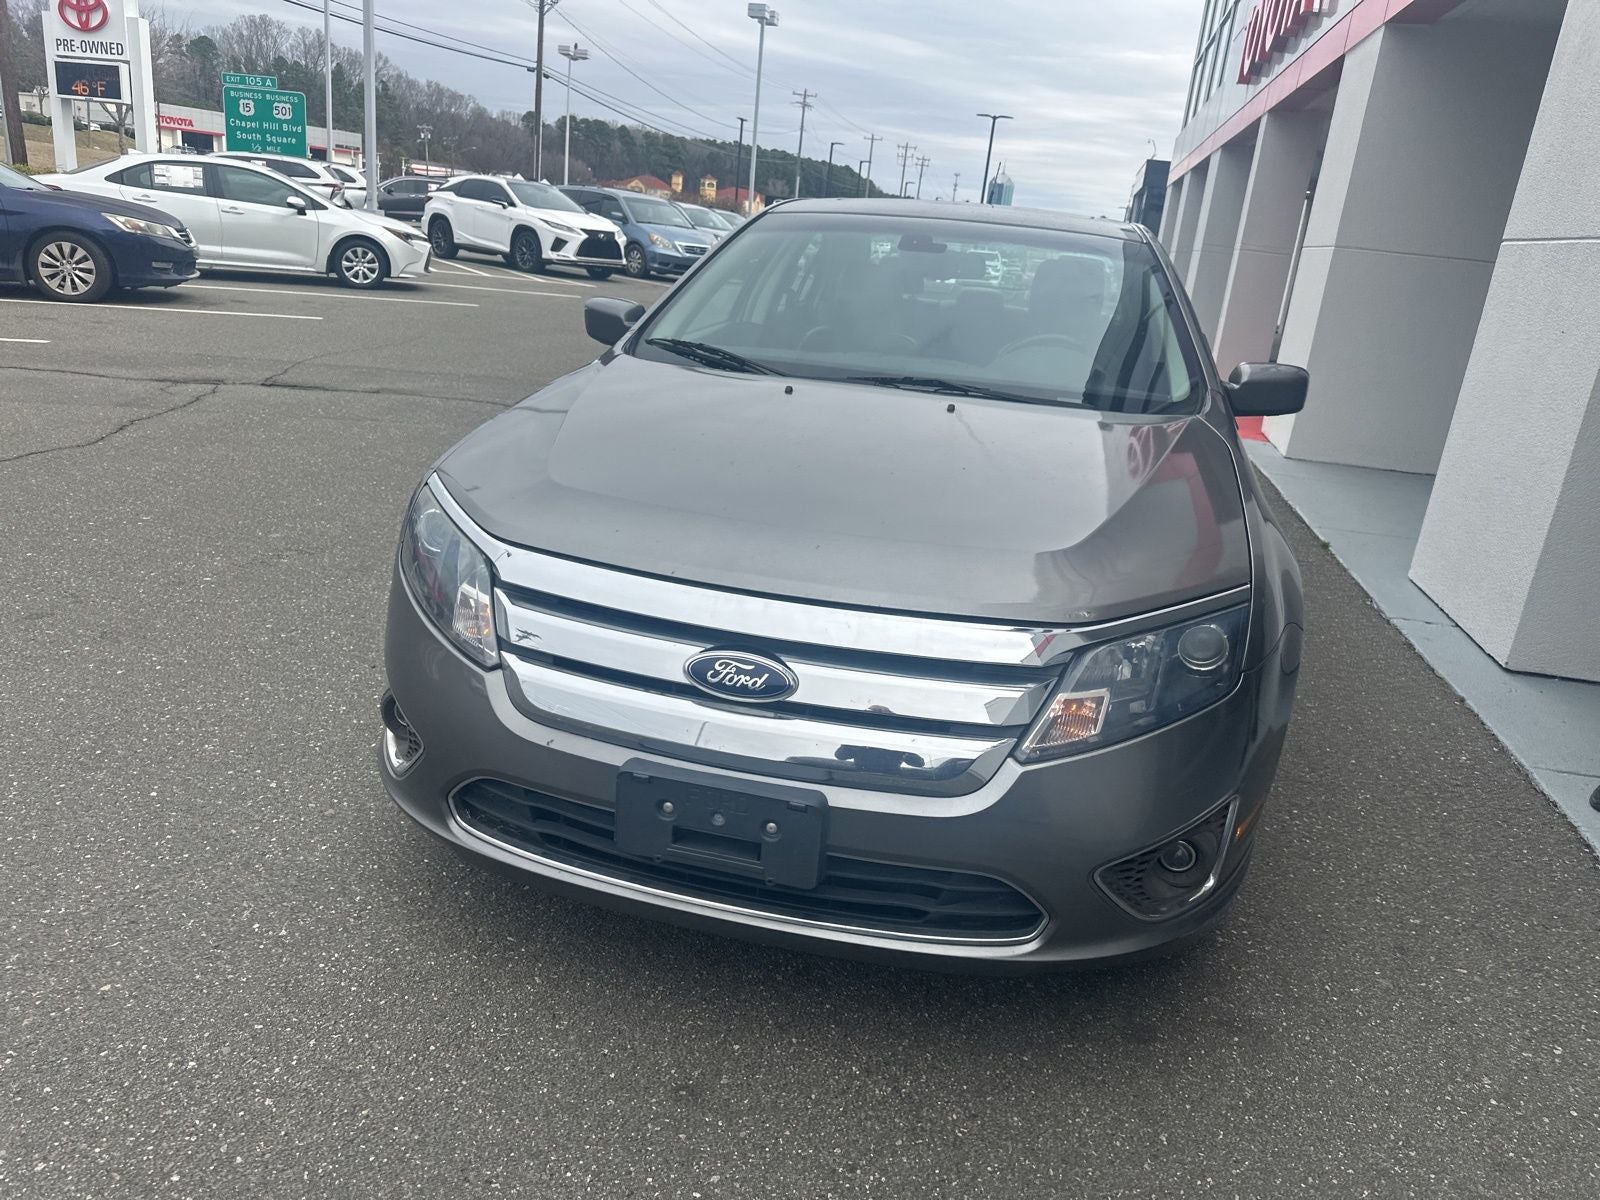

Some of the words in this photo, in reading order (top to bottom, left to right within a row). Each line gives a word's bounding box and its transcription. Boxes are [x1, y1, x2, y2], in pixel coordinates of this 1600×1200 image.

[56, 38, 124, 56] PRE-OWNED
[245, 77, 262, 86] 105
[265, 79, 272, 87] A
[230, 91, 262, 99] BUSINESS
[266, 94, 298, 103] BUSINESS
[242, 102, 251, 113] 15
[274, 106, 291, 117] 501
[160, 115, 194, 127] TOYOTA
[229, 118, 259, 129] Chapel
[262, 122, 279, 130] Hill
[282, 124, 302, 133] Blvd
[236, 131, 262, 140] South
[265, 134, 296, 145] Square
[706, 659, 769, 691] Ford
